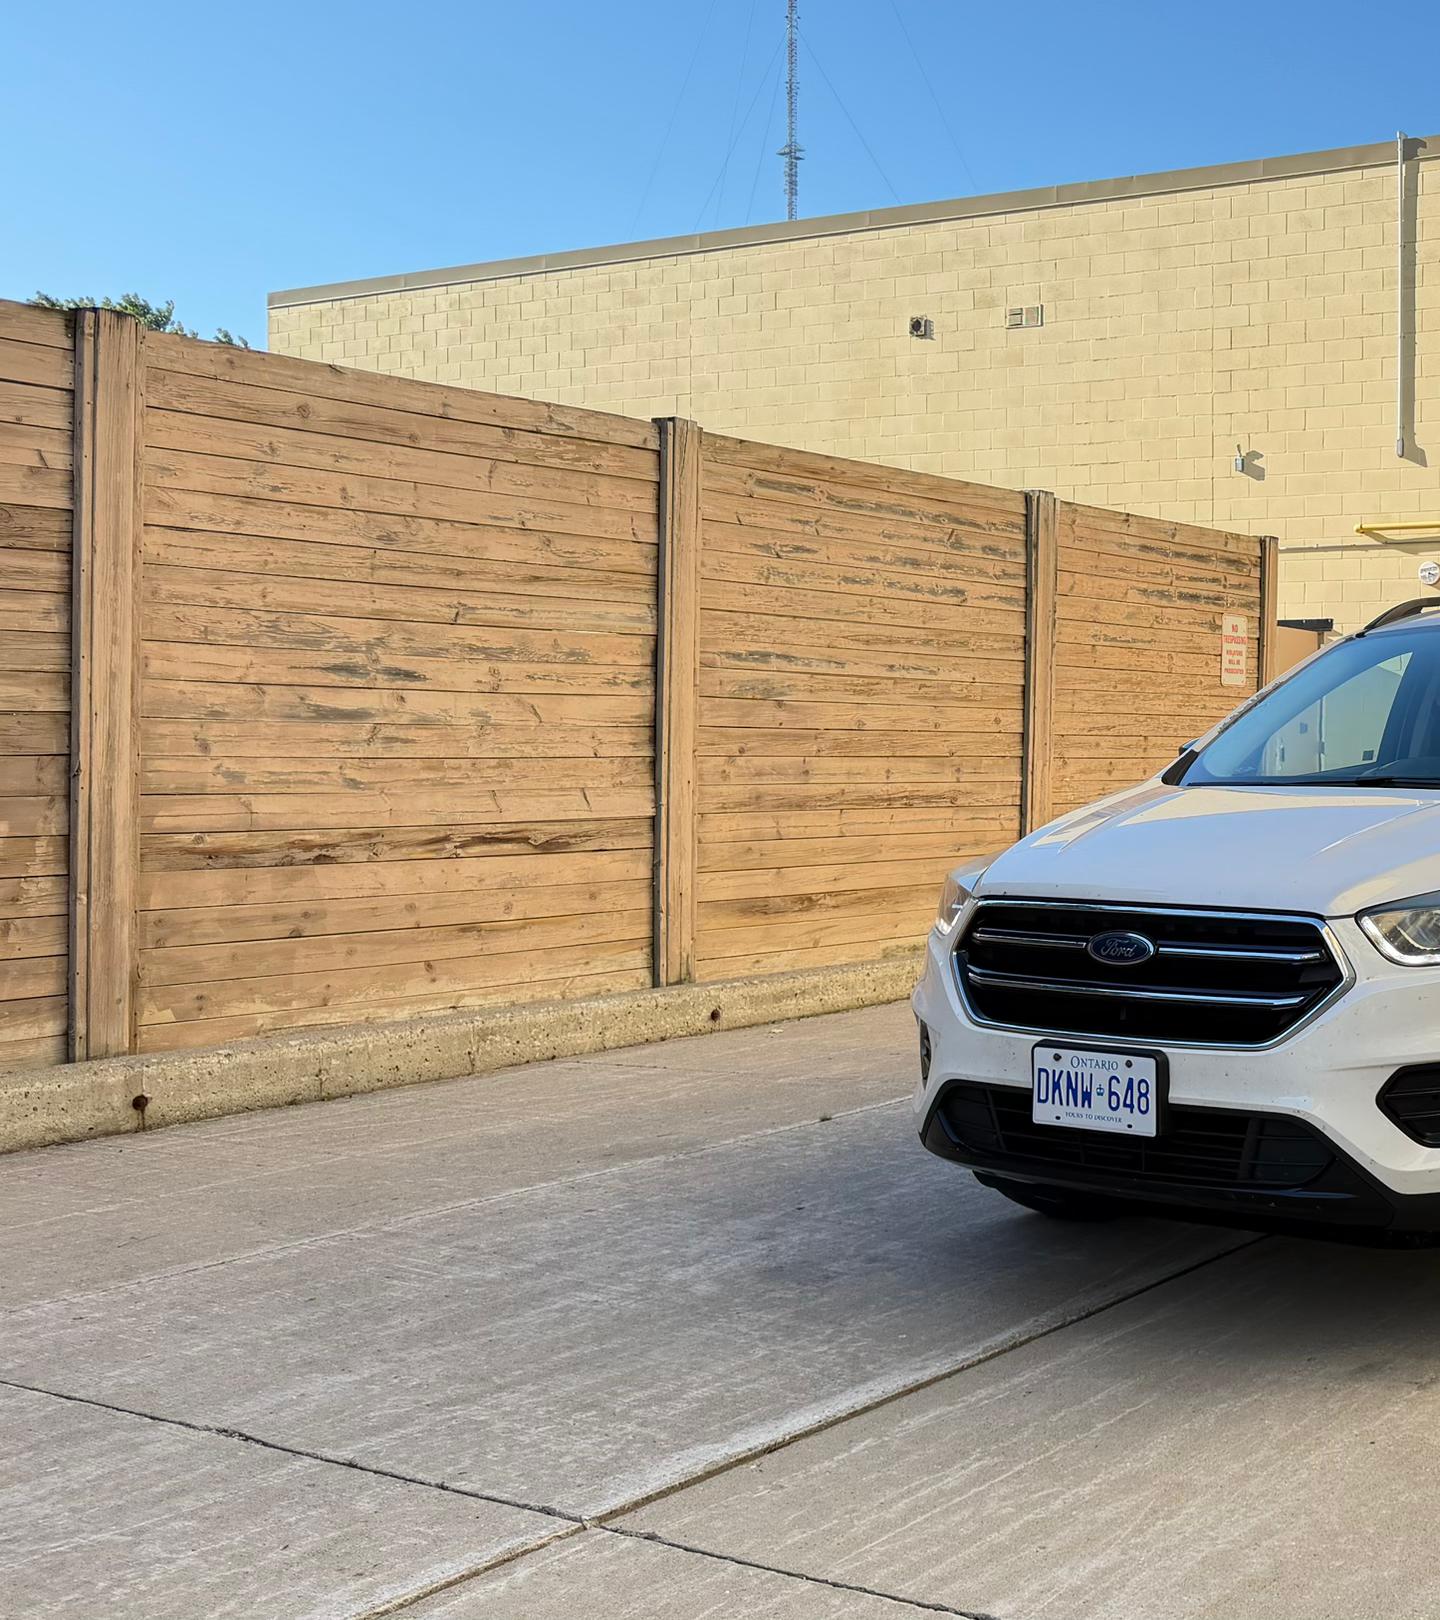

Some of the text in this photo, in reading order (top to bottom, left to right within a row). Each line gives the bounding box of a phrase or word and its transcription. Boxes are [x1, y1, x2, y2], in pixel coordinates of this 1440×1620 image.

[1100, 938, 1137, 957] Ford
[1037, 1067, 1150, 1115] DKNW 648
[1094, 1115, 1122, 1123] DISCOVER
